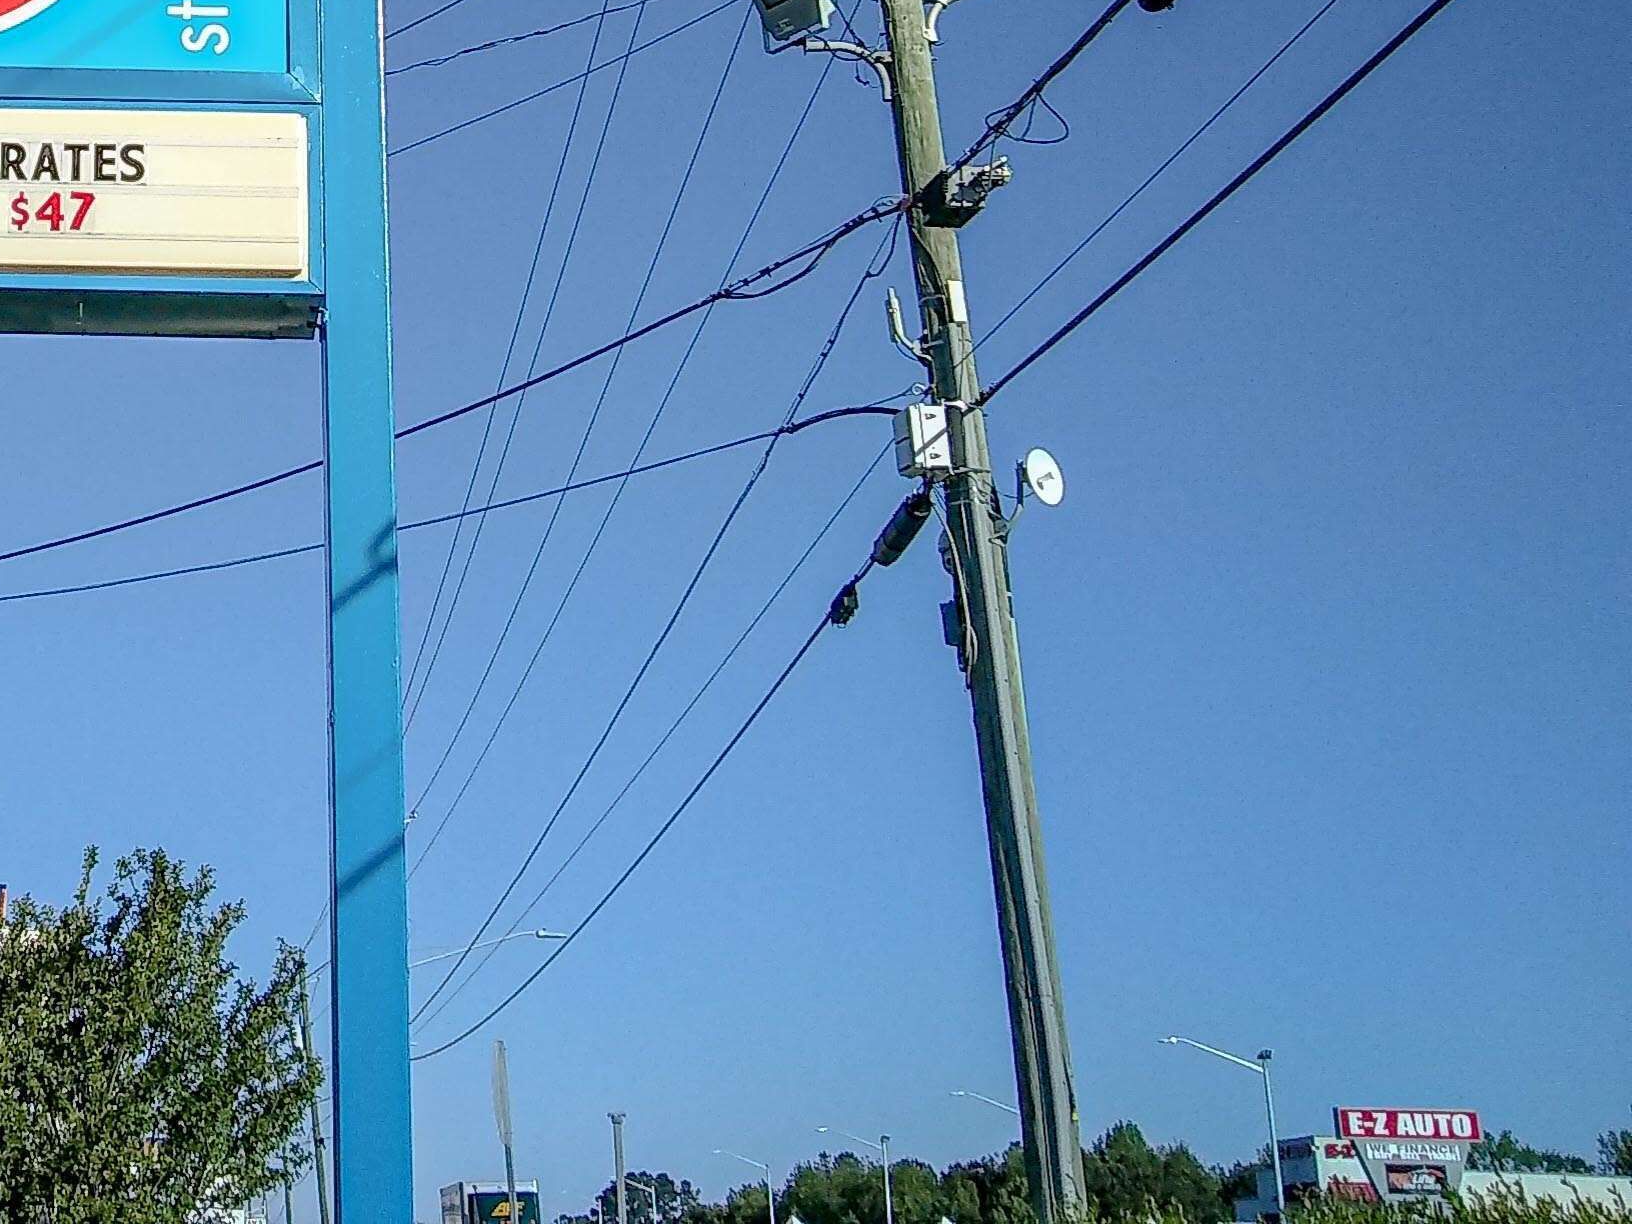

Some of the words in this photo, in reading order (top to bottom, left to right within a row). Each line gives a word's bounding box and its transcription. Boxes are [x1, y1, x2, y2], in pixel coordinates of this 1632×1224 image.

[0, 142, 147, 183] RATES
[9, 191, 97, 232] $47
[1348, 1112, 1389, 1136] E-Z
[1397, 1112, 1472, 1138] AUTO
